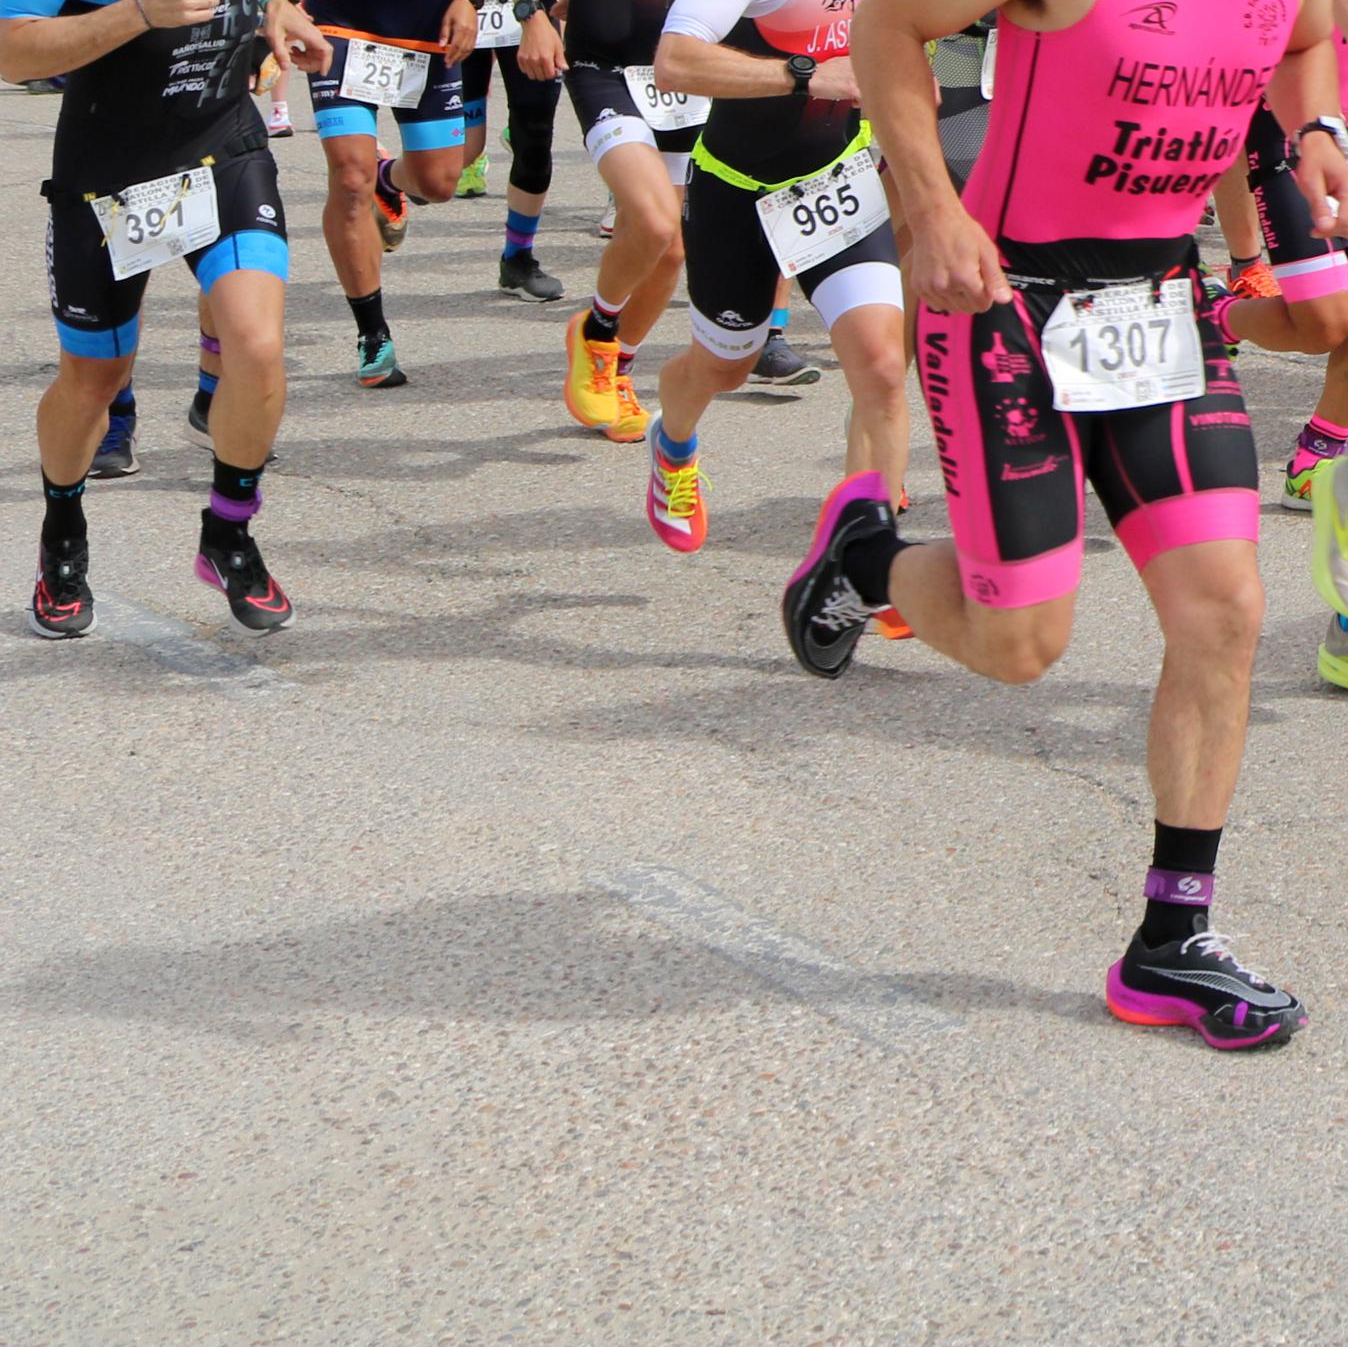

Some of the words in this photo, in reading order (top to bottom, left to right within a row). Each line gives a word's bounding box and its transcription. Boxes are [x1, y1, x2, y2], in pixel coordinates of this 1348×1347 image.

[807, 24, 822, 54] J.
[362, 62, 405, 91] 251
[125, 201, 185, 245] 391
[791, 183, 860, 237] 965
[1253, 185, 1280, 251] Valladolid
[1069, 317, 1174, 374] 1307
[925, 332, 961, 498] Valladolid
